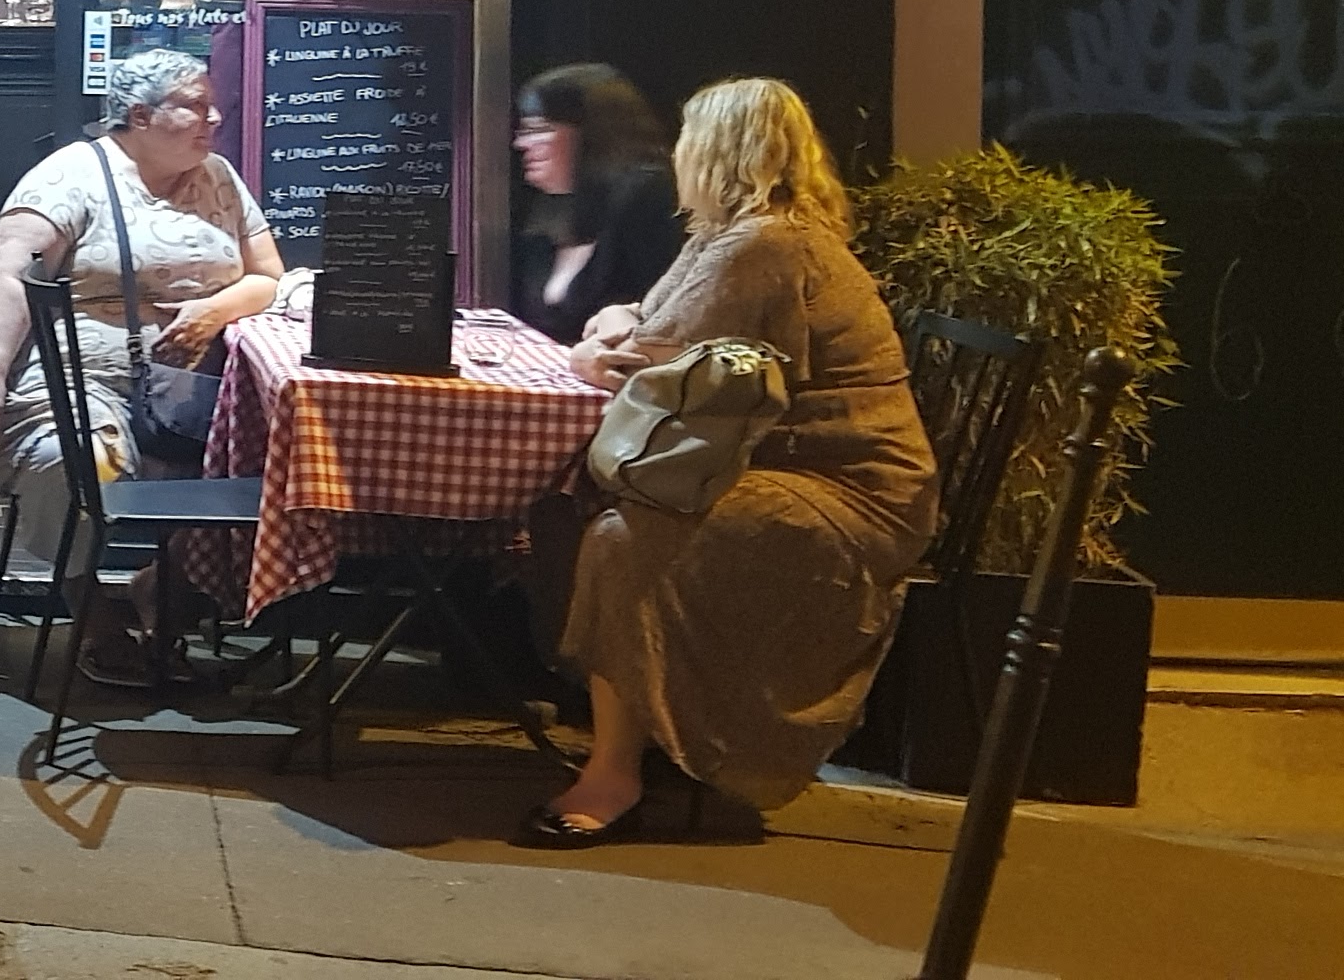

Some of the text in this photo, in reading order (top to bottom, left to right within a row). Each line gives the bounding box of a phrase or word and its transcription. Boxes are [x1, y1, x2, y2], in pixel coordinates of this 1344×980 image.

[299, 20, 339, 38] PLAT
[363, 21, 404, 36] JOUR
[288, 90, 346, 105] ASSIETTE
[288, 225, 321, 239] SOLE
